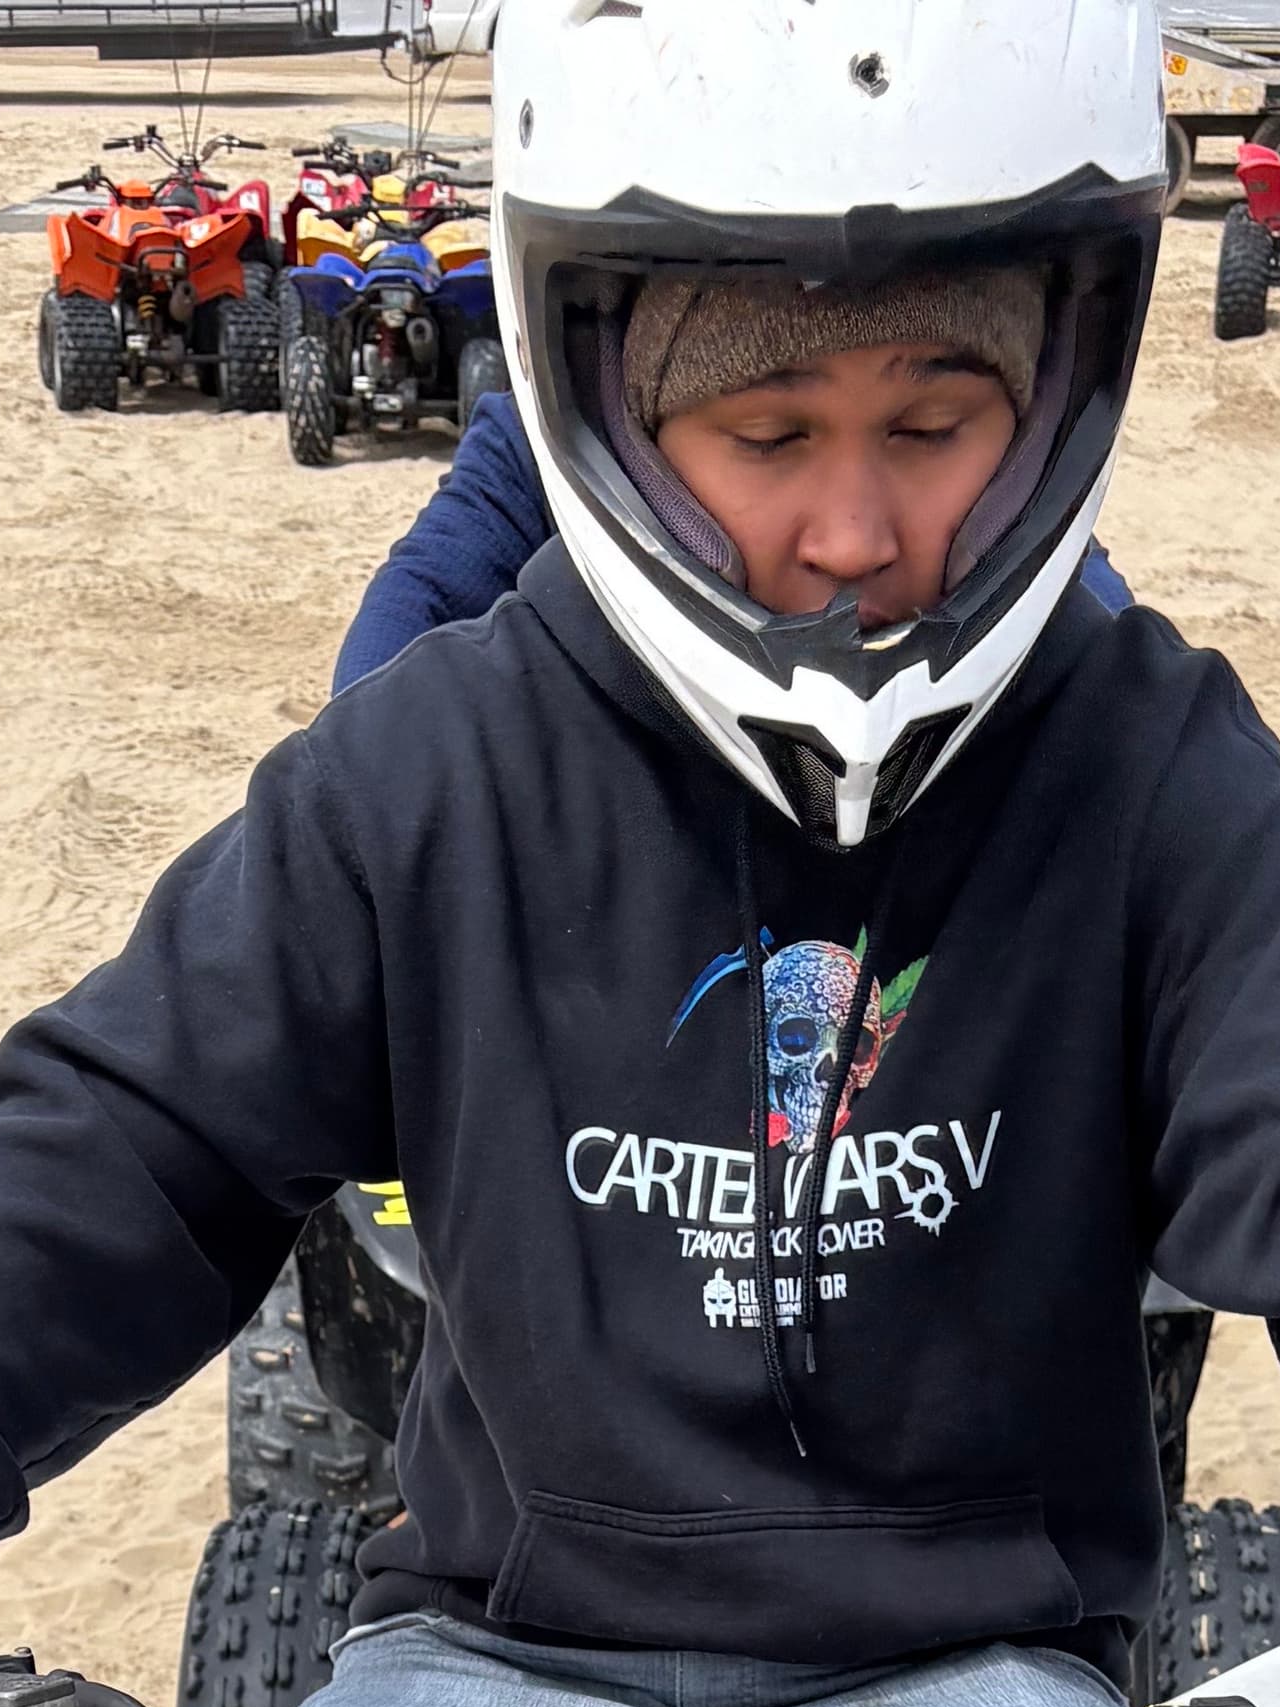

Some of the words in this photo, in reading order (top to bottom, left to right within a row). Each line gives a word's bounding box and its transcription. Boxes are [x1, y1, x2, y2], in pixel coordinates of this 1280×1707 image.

[949, 1110, 1002, 1190] V
[676, 1227, 755, 1259] TAKING
[737, 1272, 847, 1301] GLDIOR
